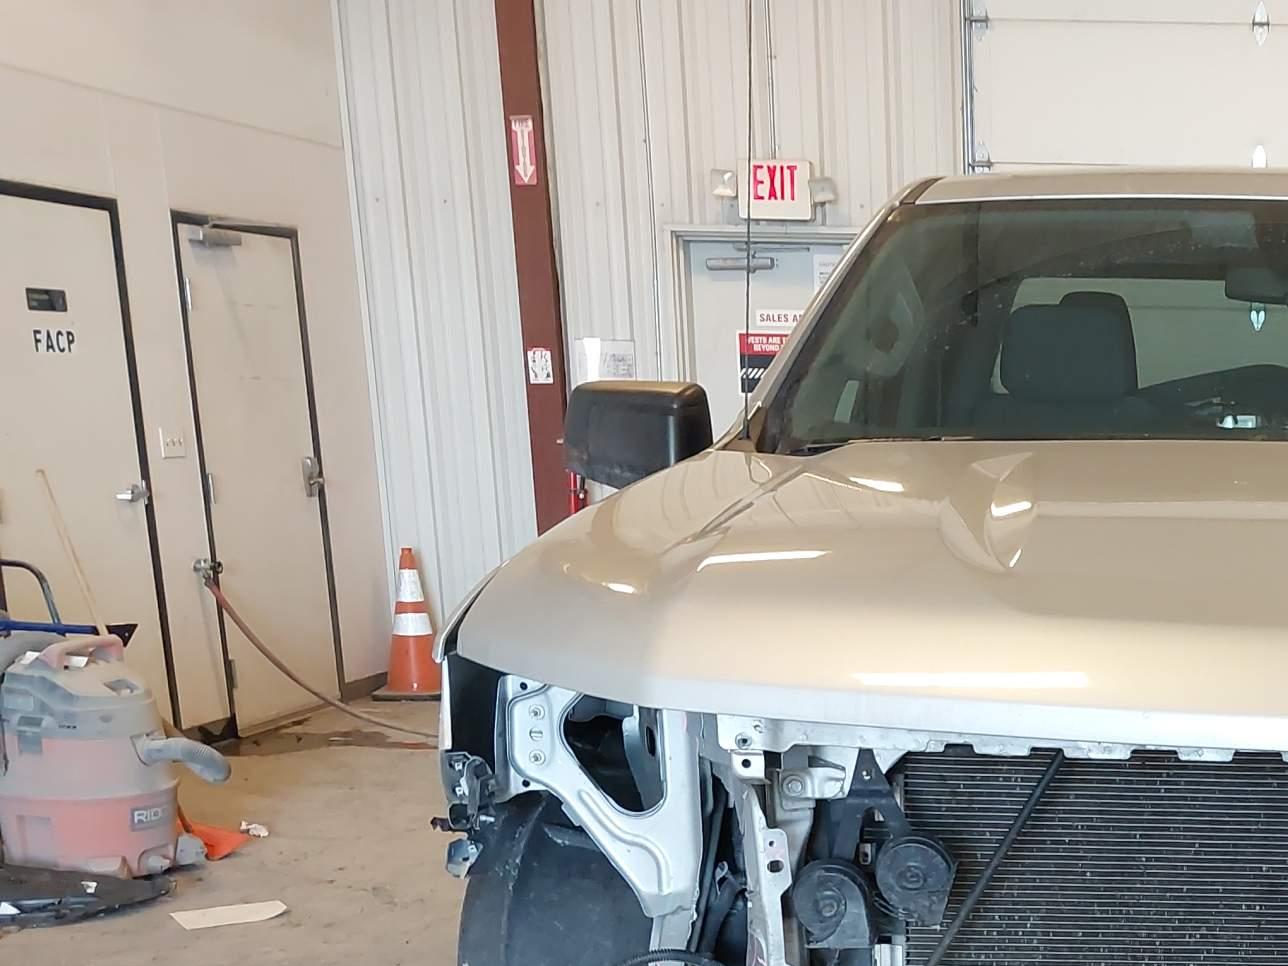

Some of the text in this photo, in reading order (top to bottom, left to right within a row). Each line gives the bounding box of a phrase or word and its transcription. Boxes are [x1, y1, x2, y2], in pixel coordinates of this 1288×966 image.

[752, 164, 798, 201] EXIT
[759, 313, 789, 323] SALES
[32, 328, 76, 353] FACP
